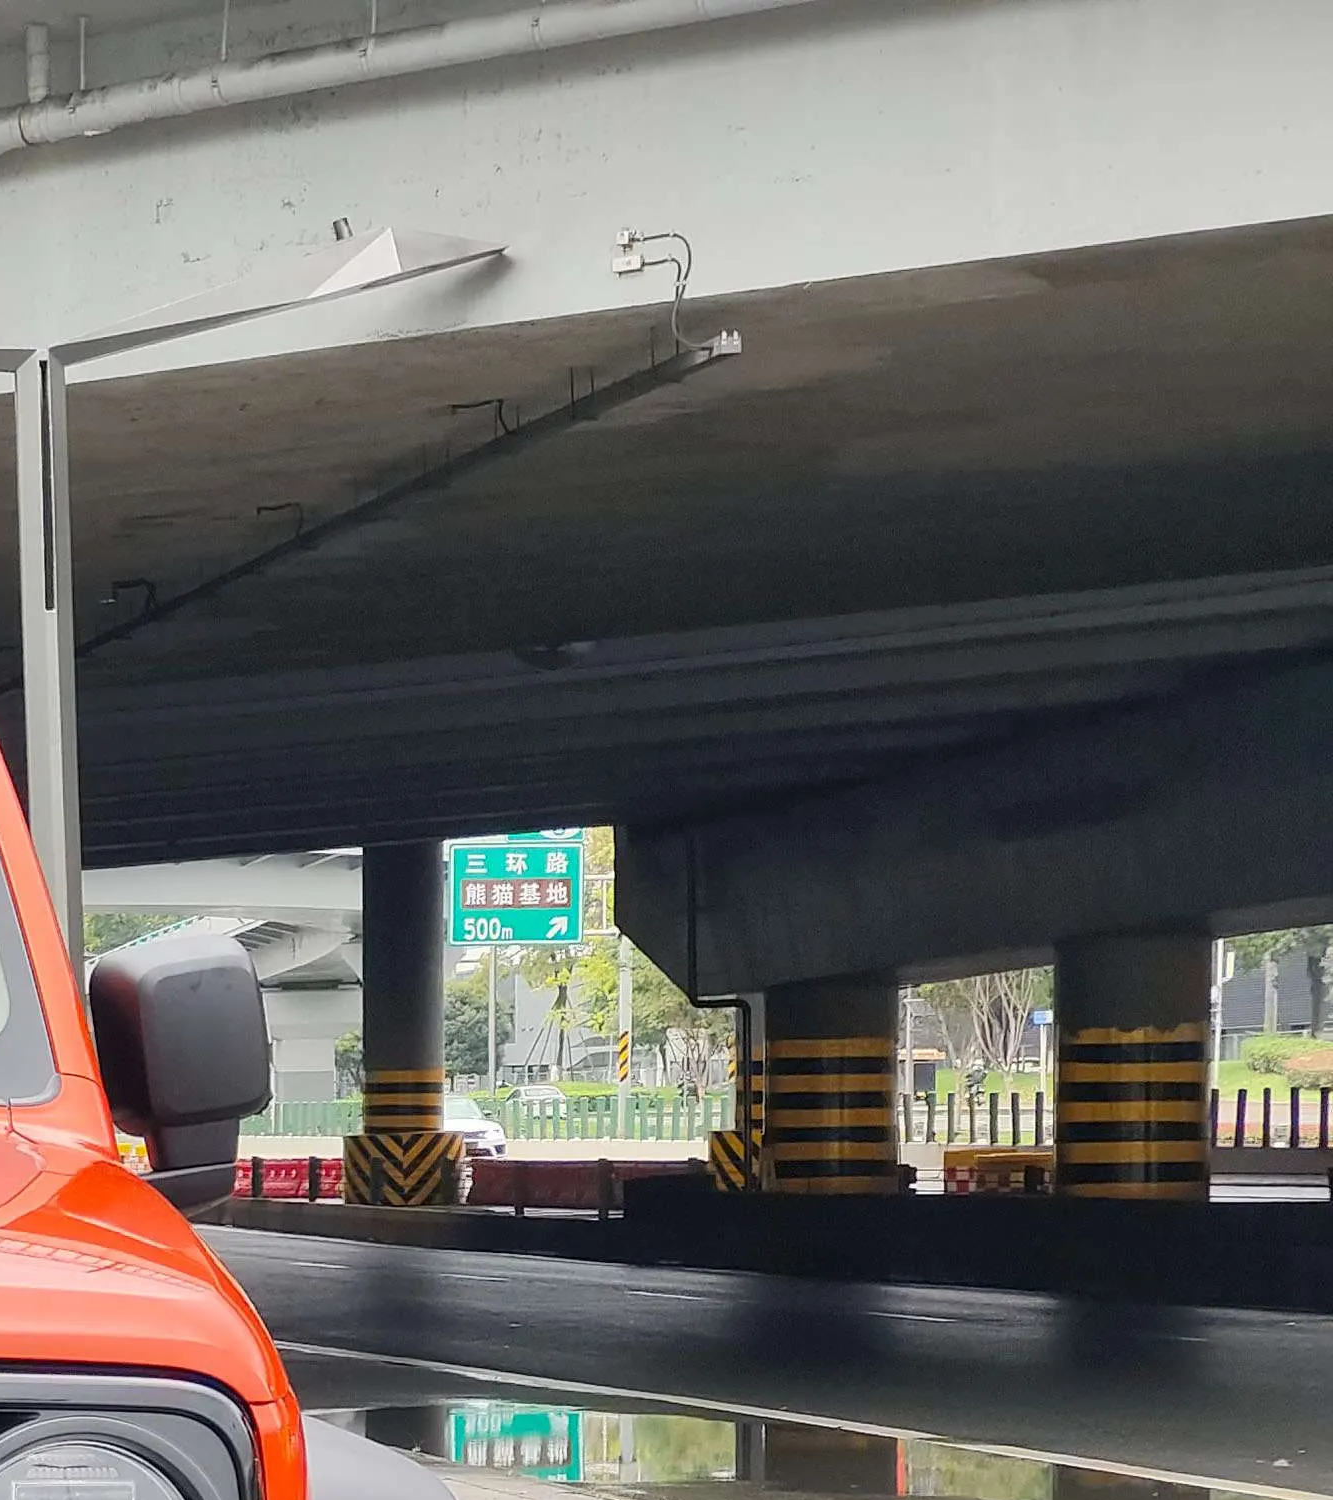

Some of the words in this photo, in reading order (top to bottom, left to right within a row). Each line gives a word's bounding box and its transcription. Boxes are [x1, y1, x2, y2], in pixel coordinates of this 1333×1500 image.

[465, 852, 569, 875] 三环路
[464, 882, 569, 906] 熊猫基地
[463, 917, 513, 940] 500m
